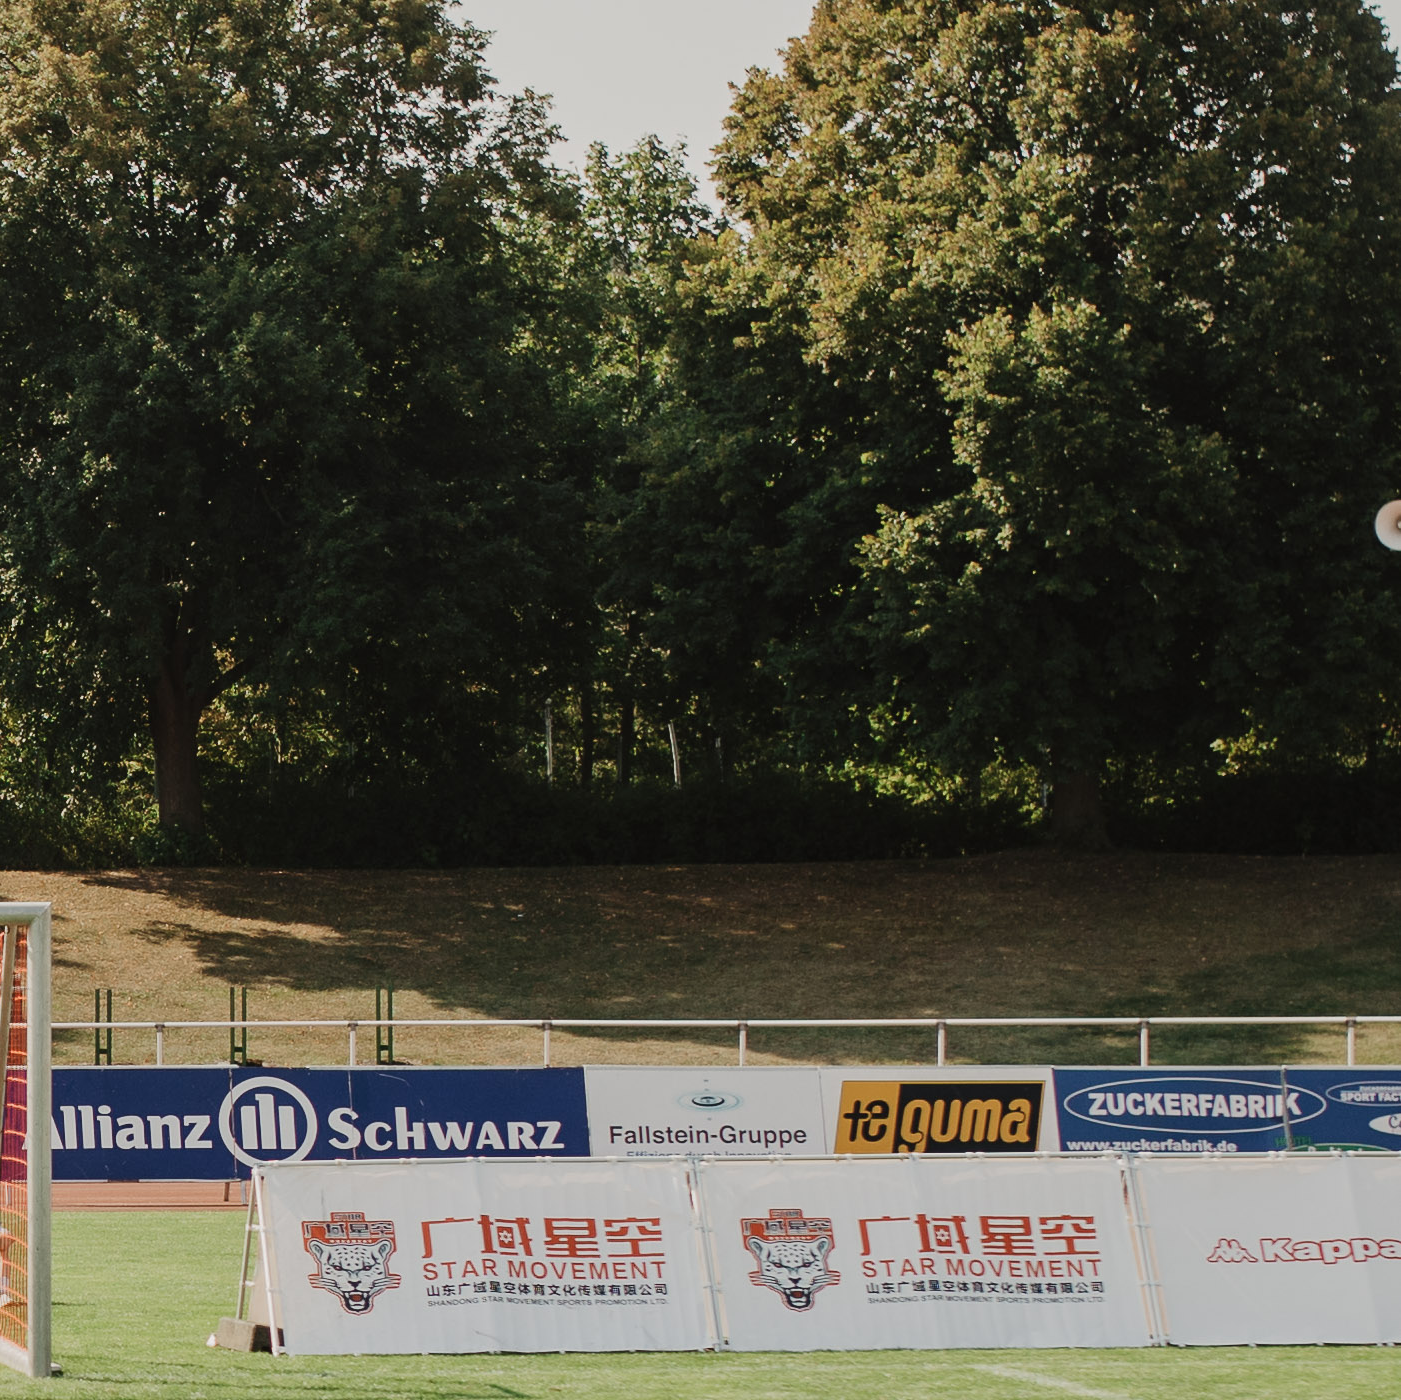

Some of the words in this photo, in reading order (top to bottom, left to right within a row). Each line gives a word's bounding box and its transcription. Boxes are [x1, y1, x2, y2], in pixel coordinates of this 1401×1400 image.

[1088, 1091, 1302, 1118] ZUCKERFABRIK
[1340, 1091, 1377, 1102] SPORT
[609, 1125, 807, 1148] Fallstein-Gruppe
[1066, 1139, 1238, 1152] www.zuckerfabrik.de
[420, 1215, 665, 1258] 广域星空
[858, 1214, 1100, 1256] 广域星空
[1259, 1238, 1401, 1264] Kappa
[423, 1258, 497, 1280] STAR
[507, 1260, 666, 1280] MOVEMENT
[862, 1258, 936, 1278] STAR
[946, 1258, 1101, 1278] MOVEMENT
[427, 1297, 480, 1307] SHANDONG
[507, 1297, 554, 1305] MOVEMENT
[557, 1298, 593, 1306] SPORTS
[595, 1298, 648, 1306] PROMOTION
[946, 1295, 993, 1303] MOVEMENT
